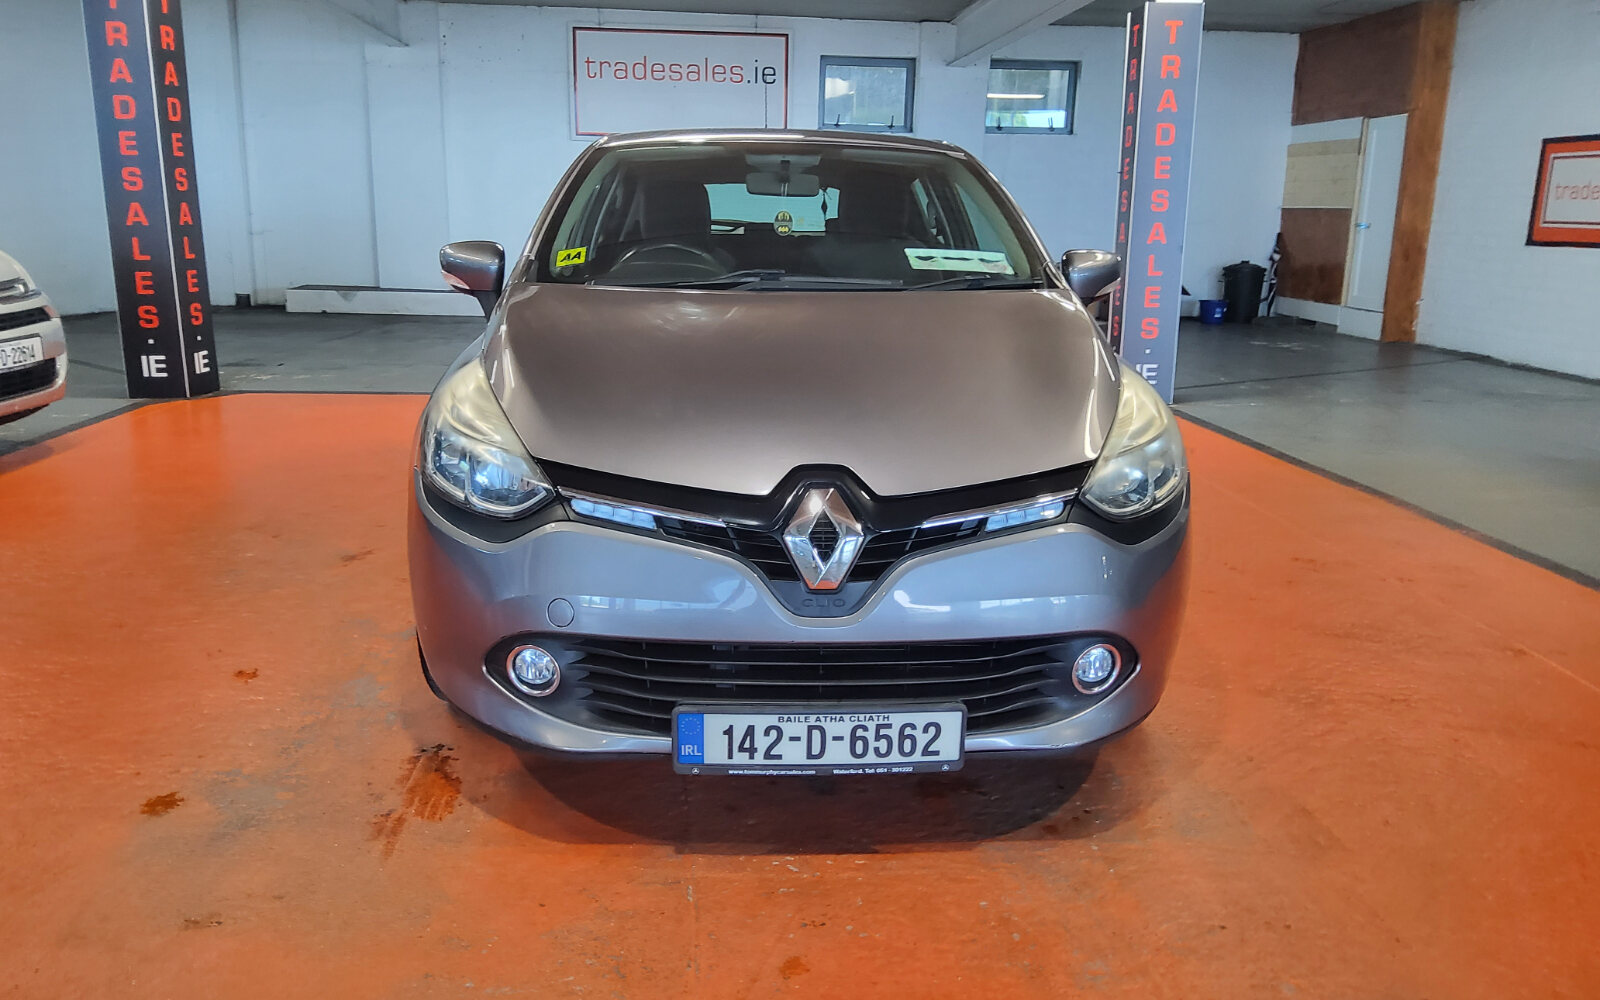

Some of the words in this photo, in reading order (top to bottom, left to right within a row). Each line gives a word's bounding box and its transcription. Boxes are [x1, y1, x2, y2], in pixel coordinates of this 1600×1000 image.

[584, 55, 777, 85] tradesales.ie
[560, 251, 582, 262] AA
[802, 598, 845, 608] CLIO
[778, 715, 811, 723] BAILE
[849, 714, 890, 722] CLIATH
[723, 721, 942, 761] 142-D-6562
[681, 745, 702, 756] IRL
